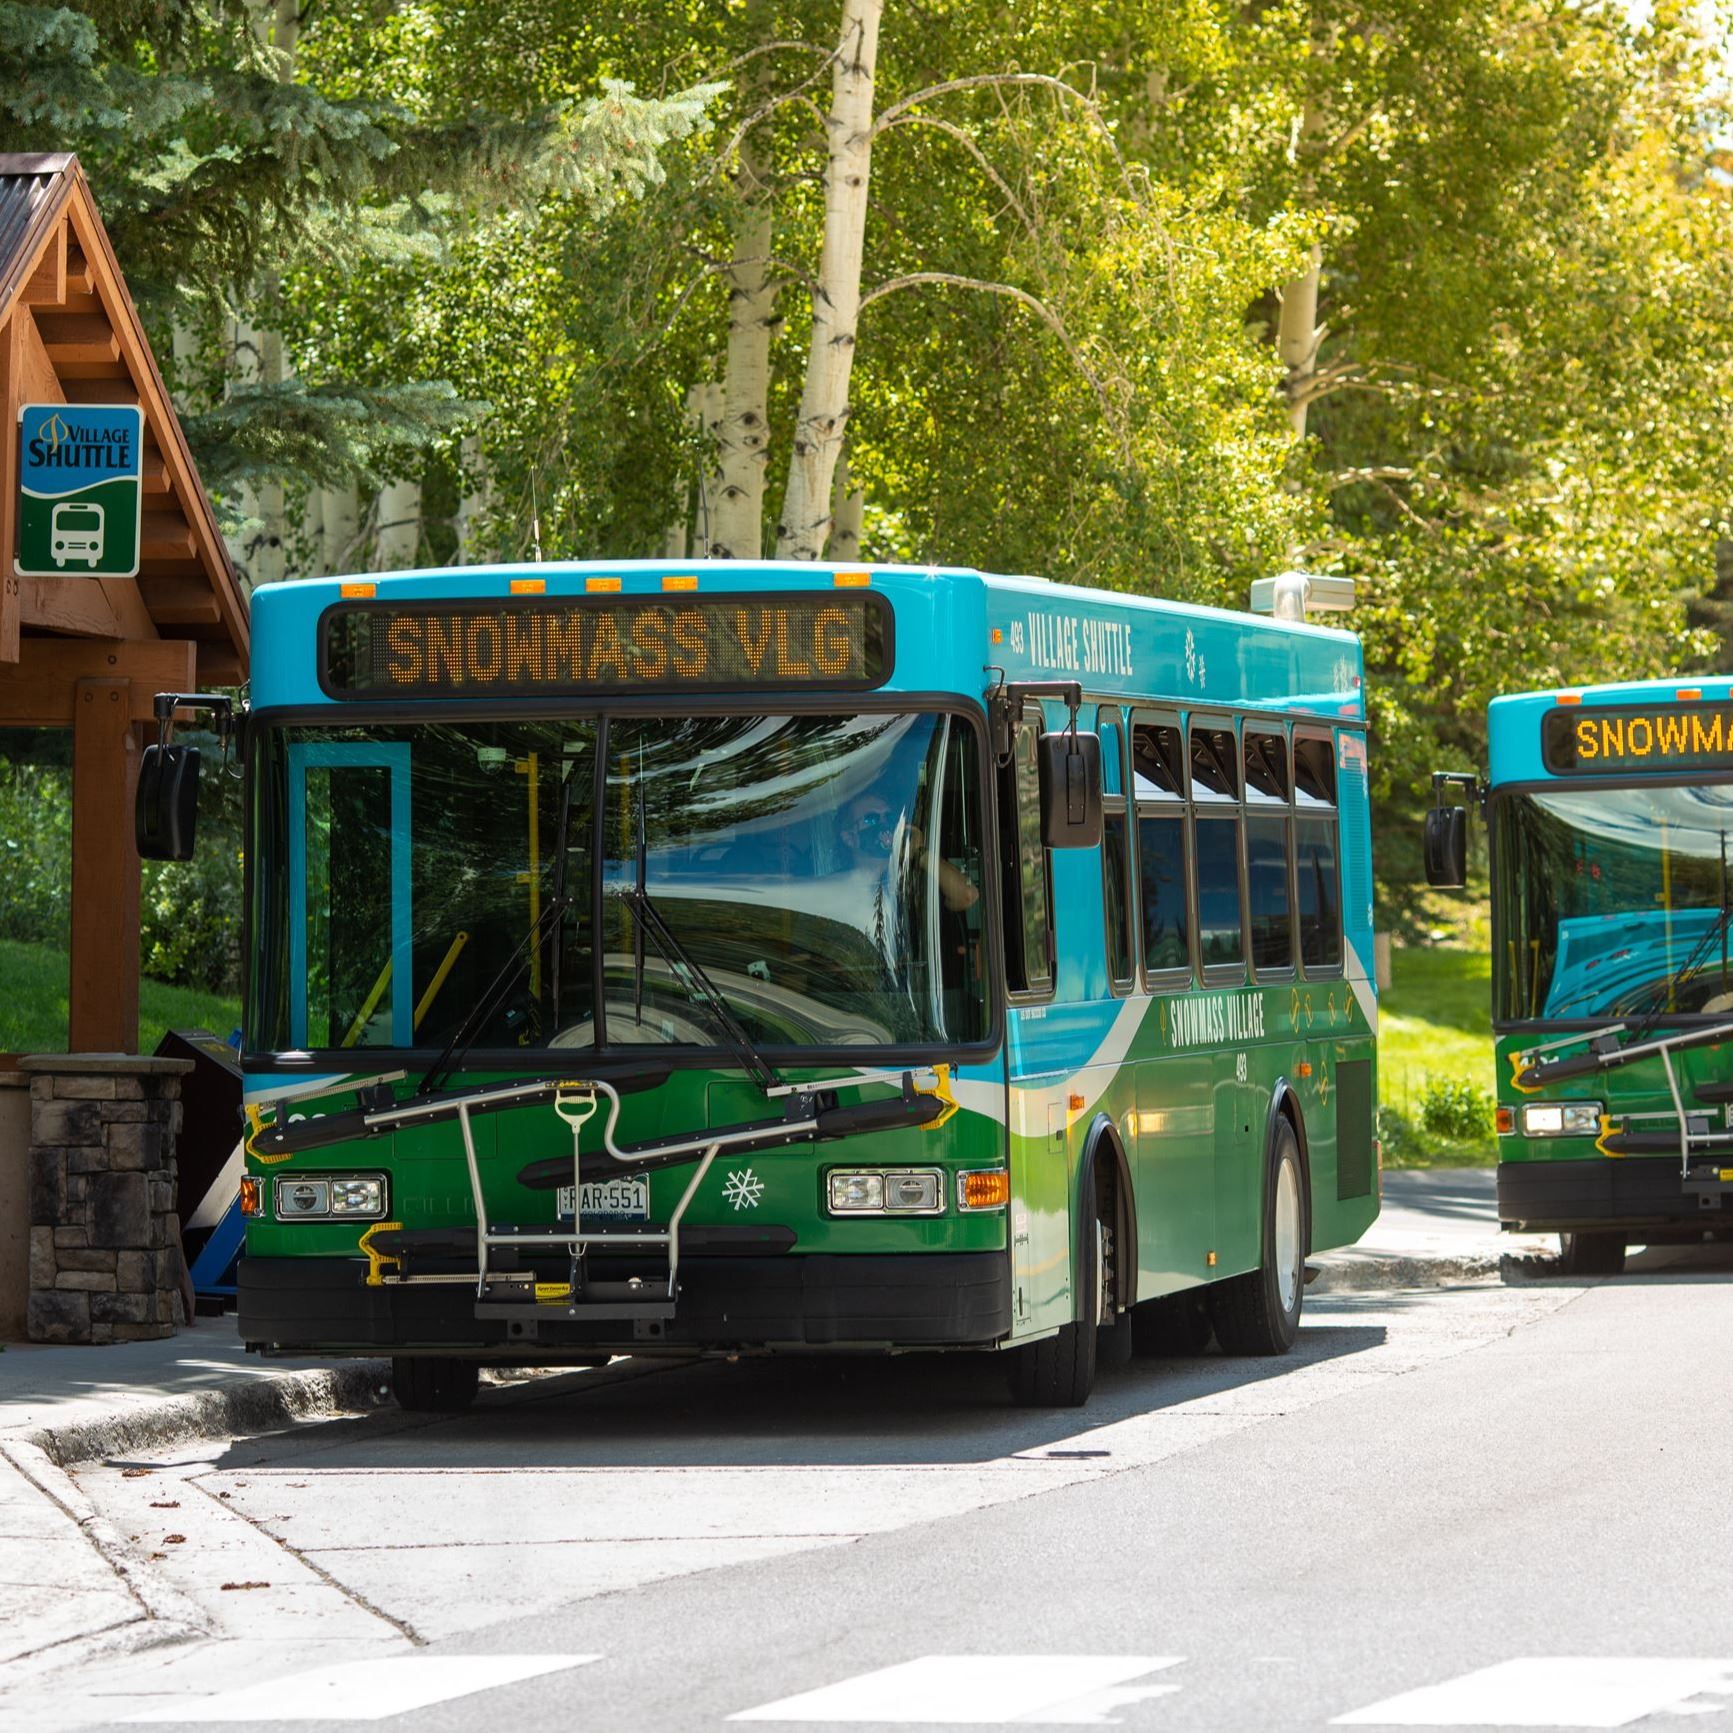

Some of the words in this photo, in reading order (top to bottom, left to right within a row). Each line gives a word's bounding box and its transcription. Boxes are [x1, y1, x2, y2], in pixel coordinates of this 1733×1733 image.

[28, 437, 131, 468] SHUTTLE
[68, 425, 130, 443] VILLAGE
[386, 610, 708, 683] SNOWMASS
[735, 607, 851, 677] VLG
[1010, 621, 1024, 654] 493
[1028, 612, 1079, 670] VILLAGE
[1082, 618, 1132, 676] SHUTTLE
[1170, 995, 1226, 1049] SNOWMASS
[1226, 992, 1265, 1041] VILLAGE
[1236, 1052, 1247, 1082] 493
